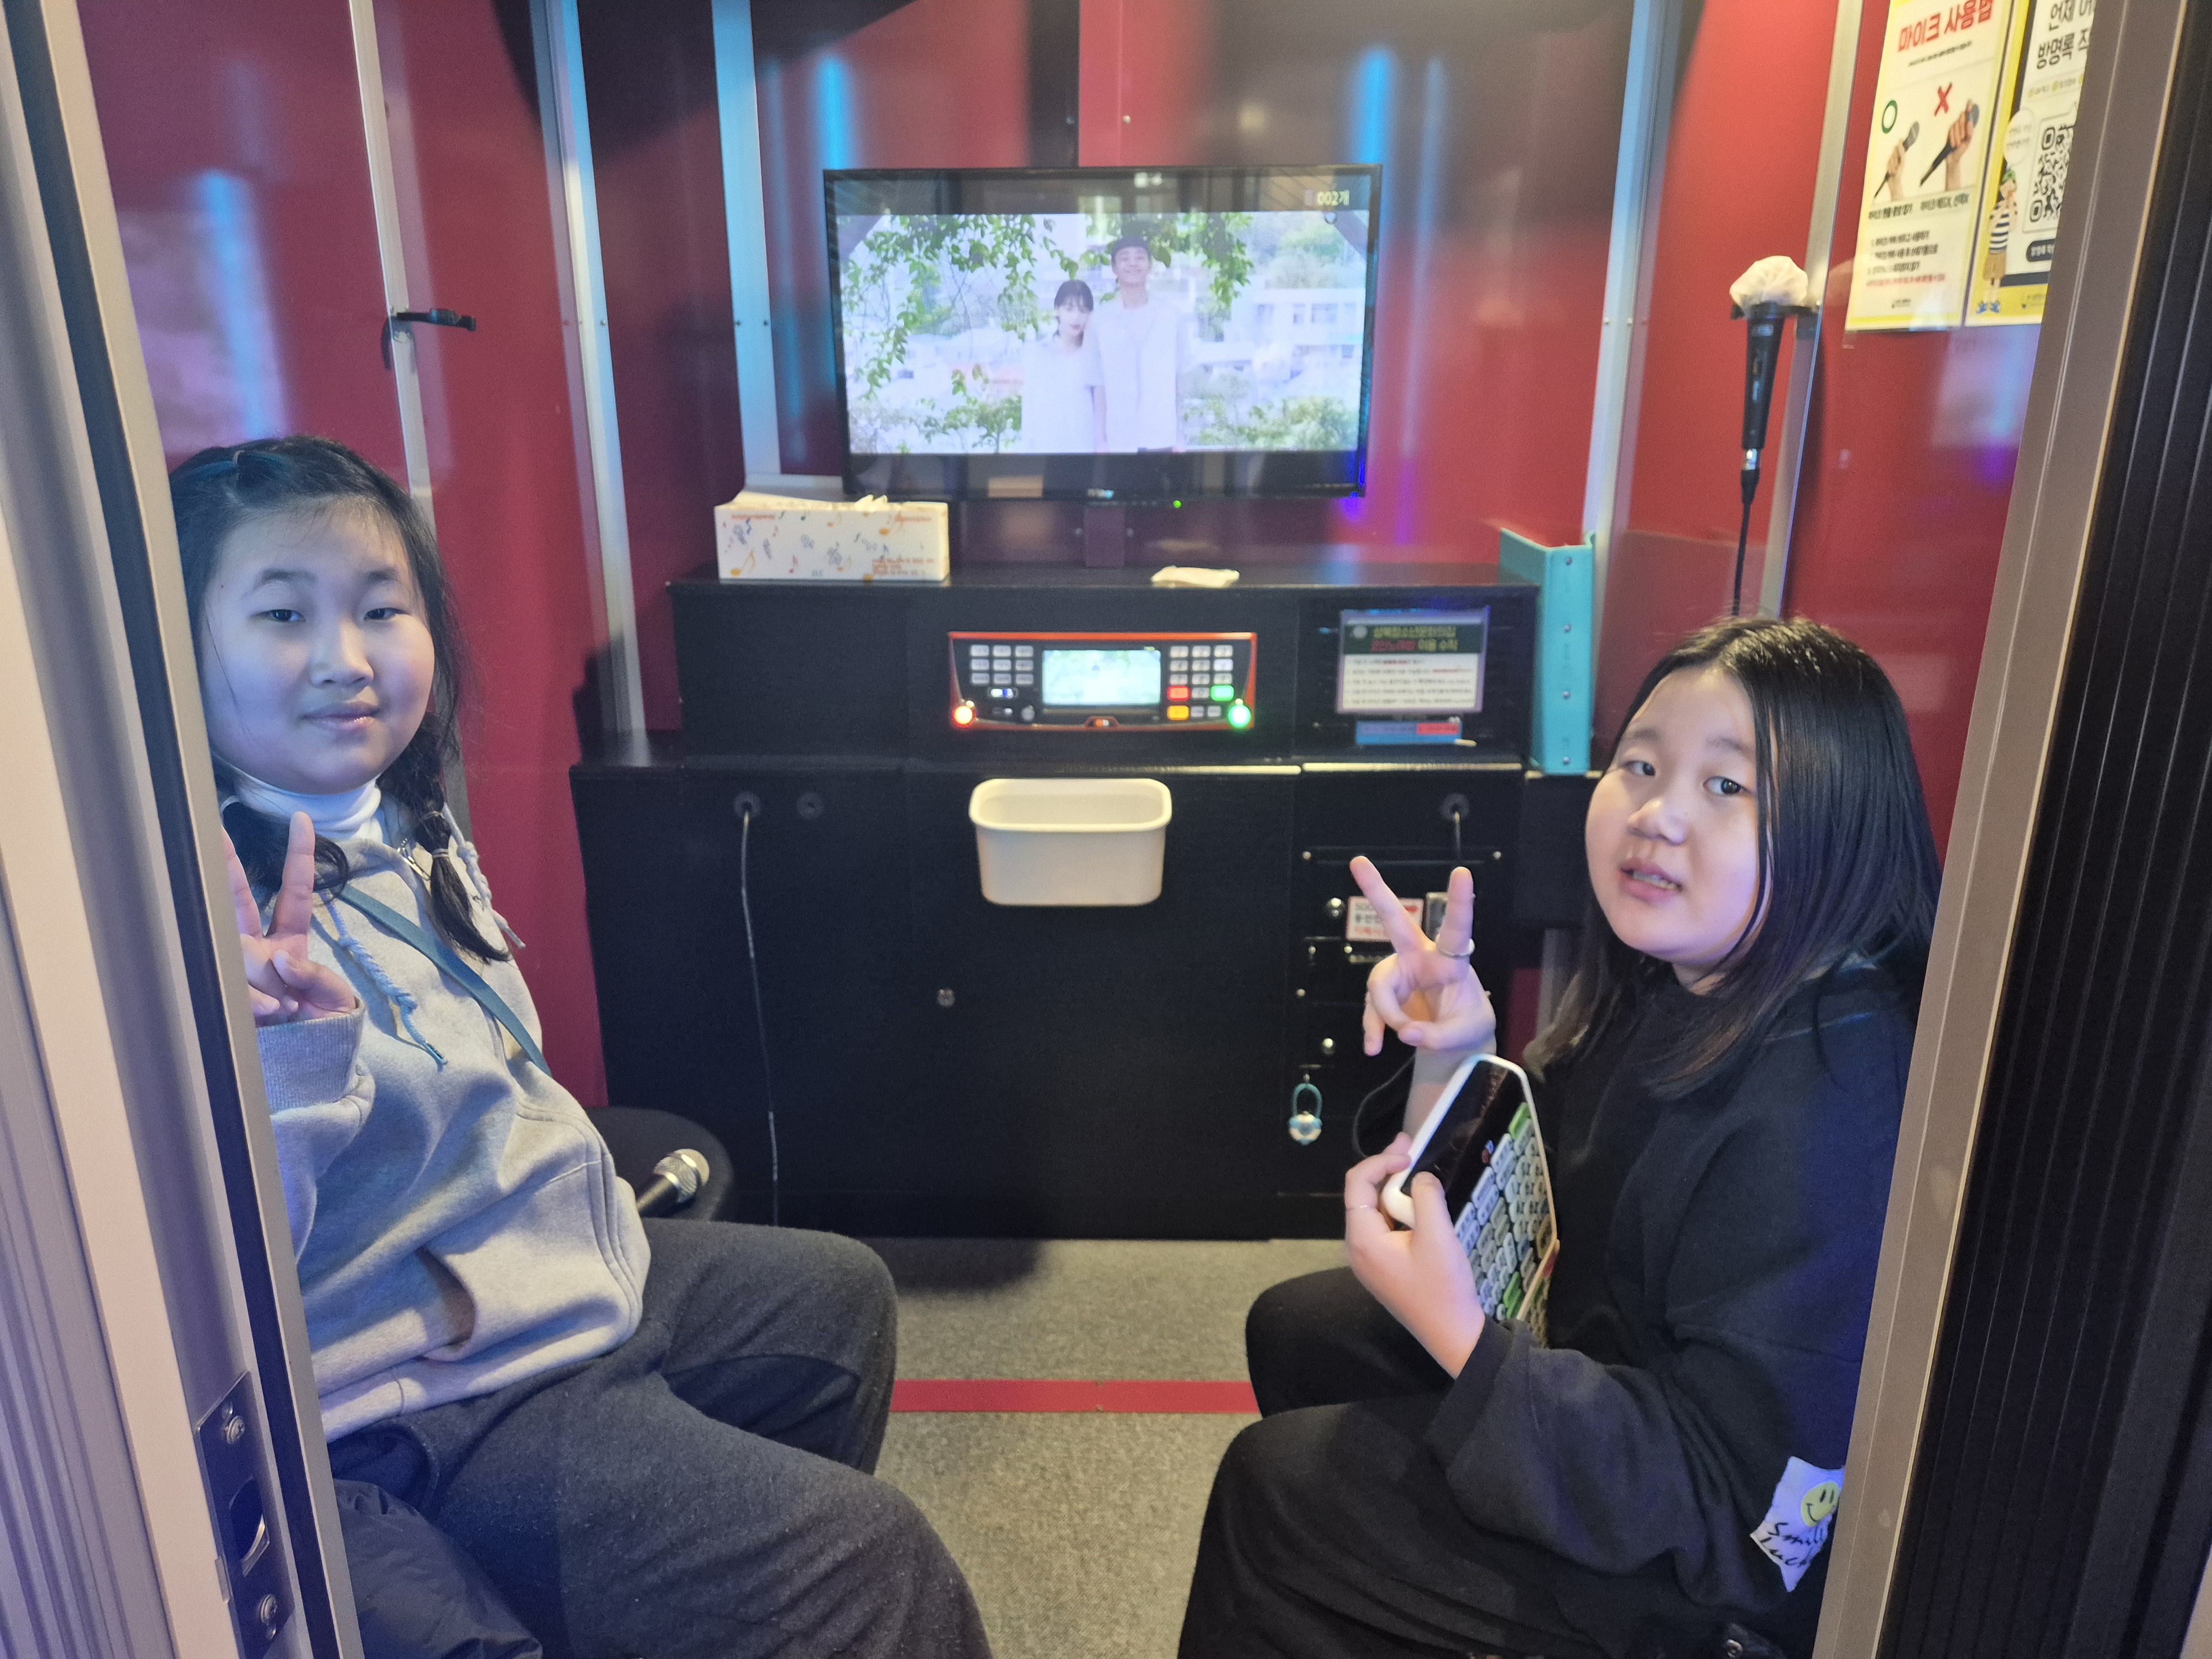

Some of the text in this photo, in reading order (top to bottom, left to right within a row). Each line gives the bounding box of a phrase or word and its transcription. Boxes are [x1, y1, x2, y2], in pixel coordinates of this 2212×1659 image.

[1898, 0, 1994, 53] 마이크 사용법
[2037, 32, 2075, 70] 방명록
